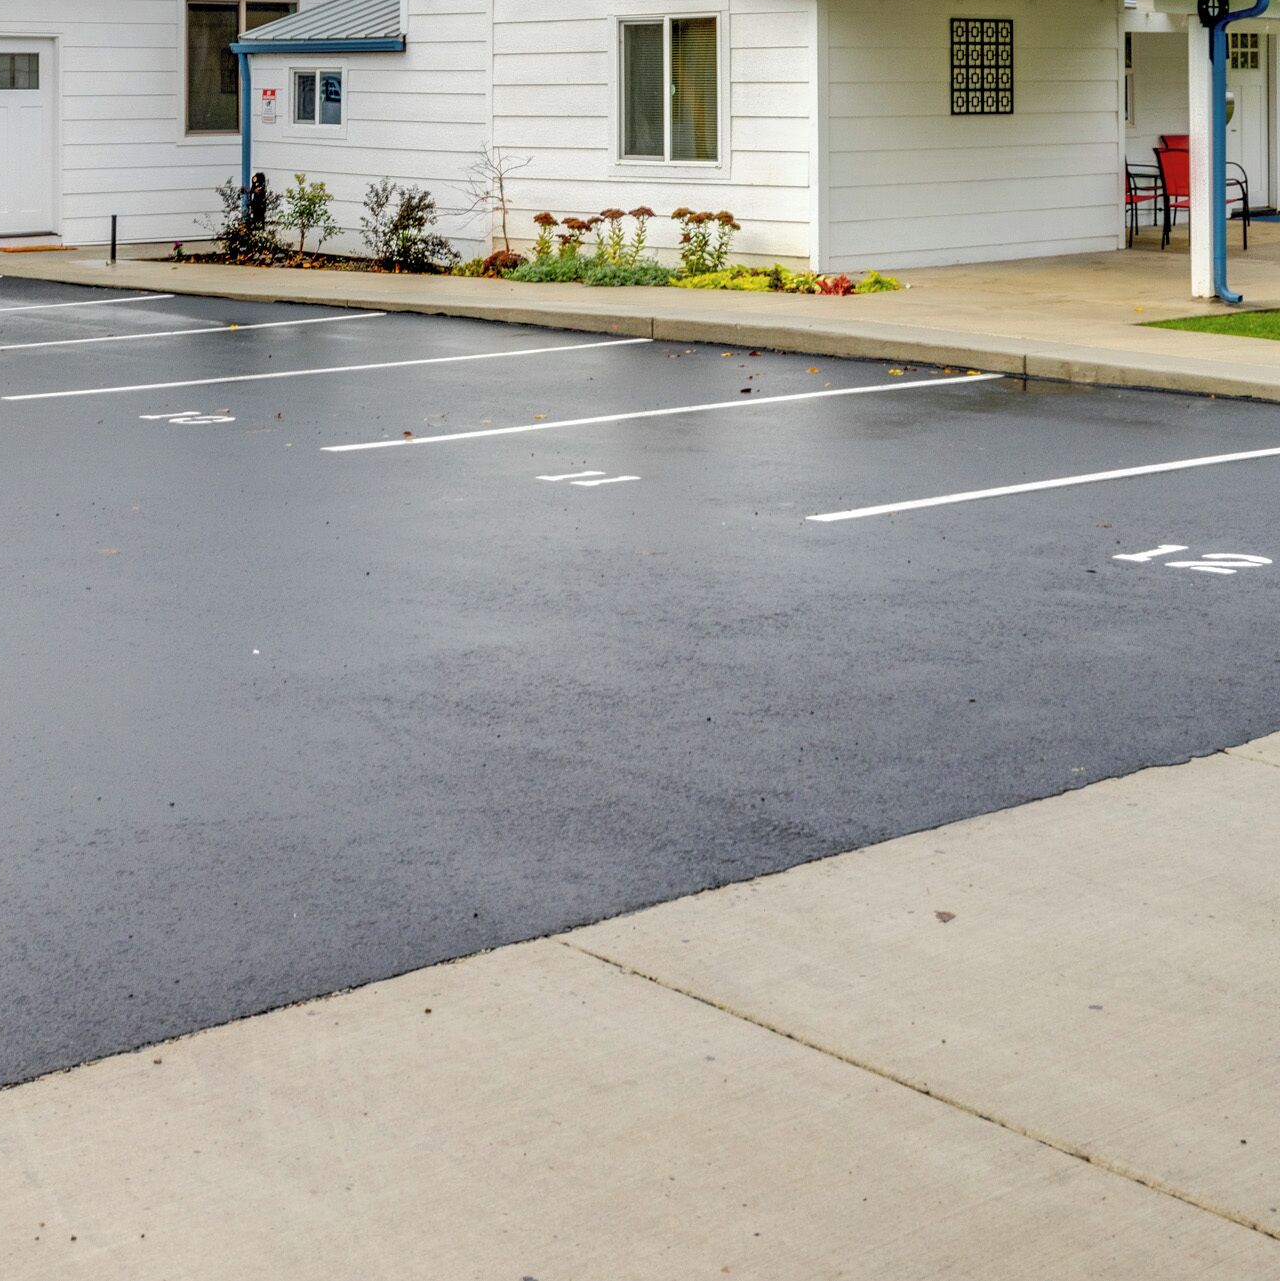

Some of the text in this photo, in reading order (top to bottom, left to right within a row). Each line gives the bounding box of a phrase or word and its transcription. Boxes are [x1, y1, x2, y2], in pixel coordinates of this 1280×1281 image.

[139, 411, 236, 424] 10
[535, 471, 642, 487] 11
[1111, 544, 1273, 575] 12
